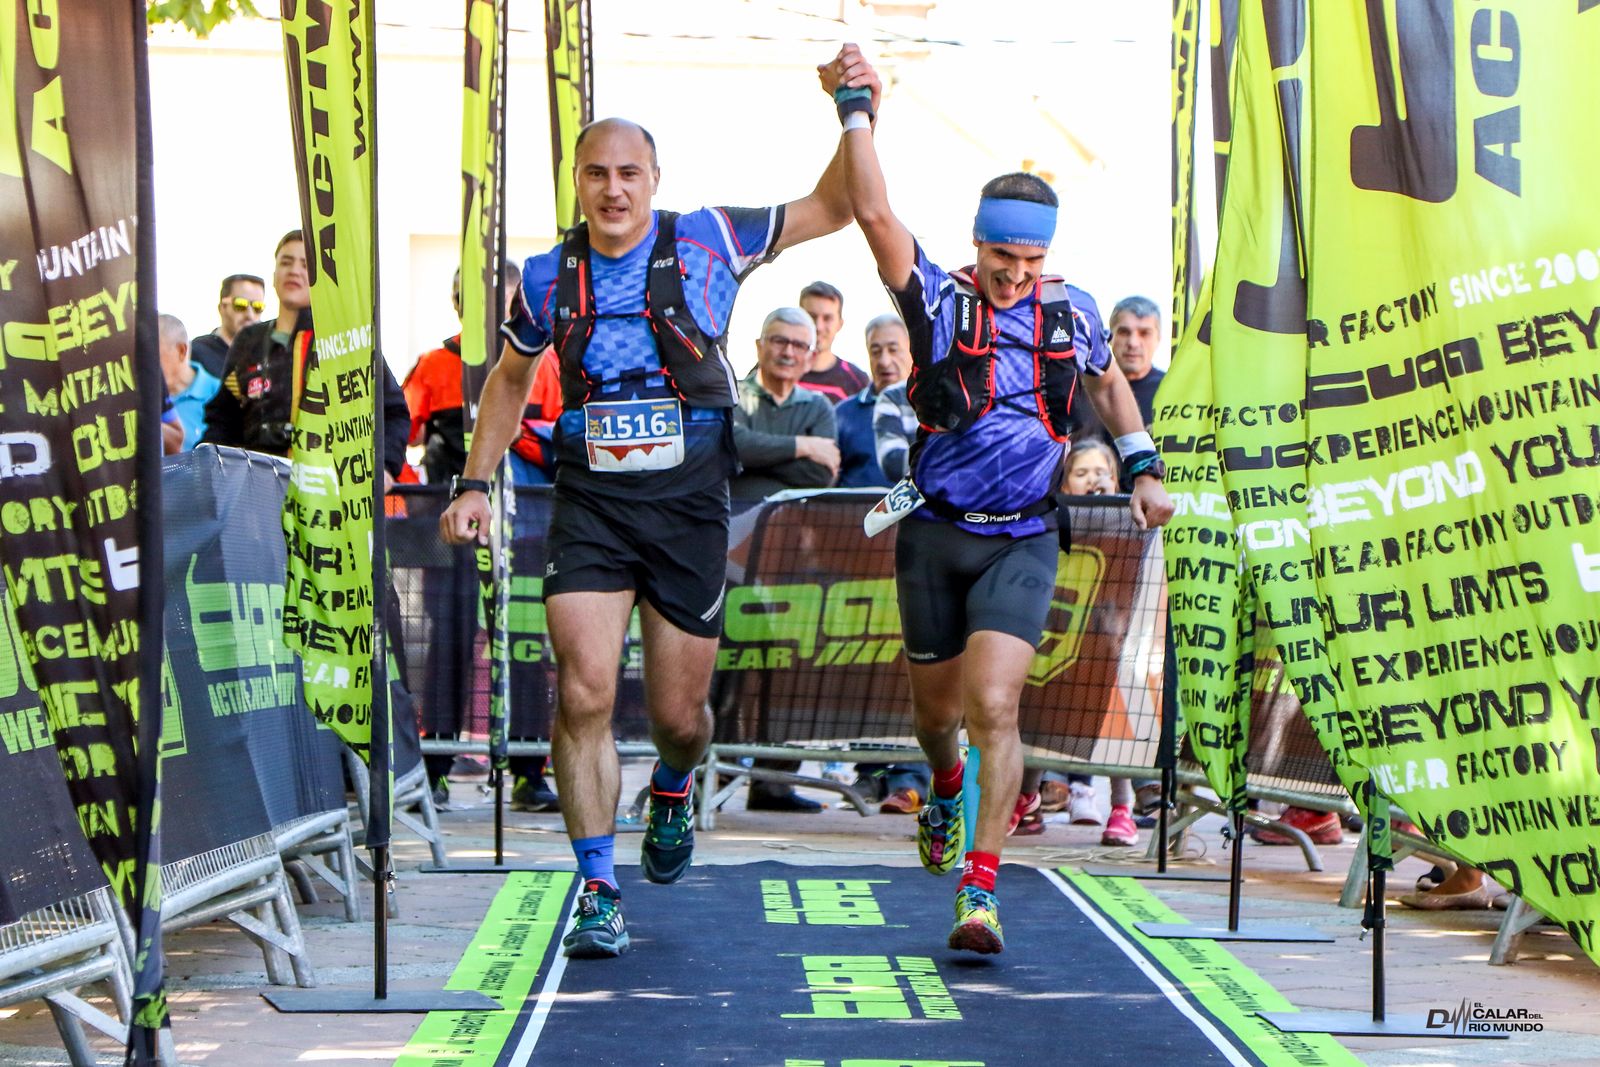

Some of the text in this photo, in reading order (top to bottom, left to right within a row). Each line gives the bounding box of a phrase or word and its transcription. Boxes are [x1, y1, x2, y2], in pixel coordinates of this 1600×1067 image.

[36, 219, 131, 283] UNTAIN
[1340, 283, 1439, 345] FACTORY
[1449, 260, 1533, 309] SINCE
[47, 280, 138, 363] BEY
[1496, 305, 1600, 366] BEY
[601, 411, 668, 440] 1516
[1458, 372, 1600, 434] MOUNTAIN
[1308, 450, 1487, 531] BEYOND
[1490, 422, 1600, 484] YOU
[989, 511, 1022, 524] Kalenji
[1404, 509, 1509, 563] FACTORY
[1511, 492, 1600, 535] OUTD
[1351, 628, 1535, 688] EXPERIENCE
[1363, 681, 1554, 751] BEYOND
[1455, 740, 1568, 786] FACTORY
[1417, 797, 1560, 845] MOUNTAIN
